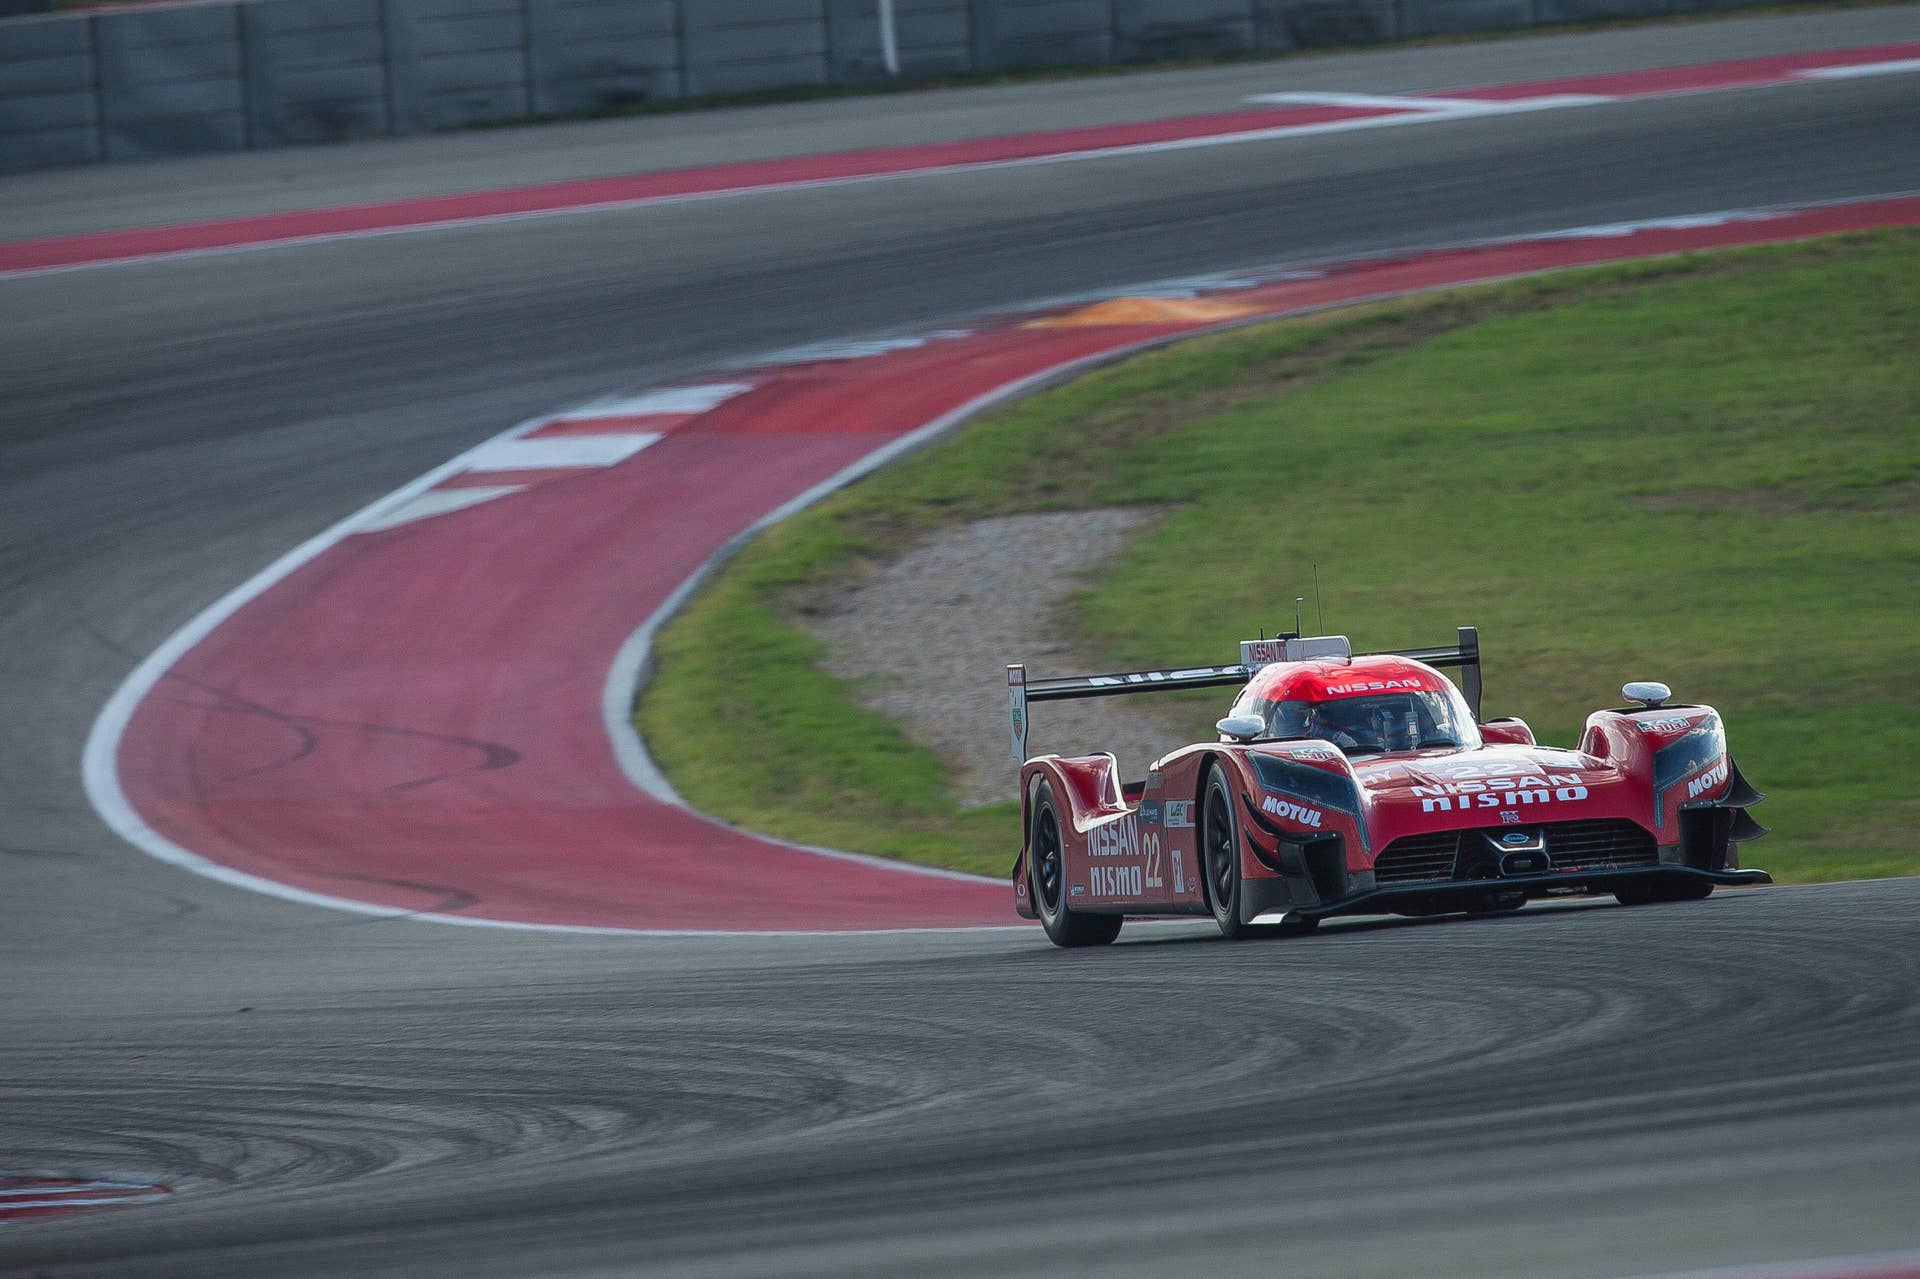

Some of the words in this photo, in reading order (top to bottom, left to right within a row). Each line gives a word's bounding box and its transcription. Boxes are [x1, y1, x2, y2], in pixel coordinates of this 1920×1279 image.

[1248, 642, 1279, 662] NISSAN
[1326, 680, 1421, 695] NISSAN
[1410, 773, 1583, 797] NISSAN
[1445, 763, 1526, 780] 22
[1688, 761, 1728, 798] MOTU
[1262, 796, 1322, 828] MOTUL
[1087, 814, 1139, 856] NISSAN
[1143, 832, 1162, 888] 22
